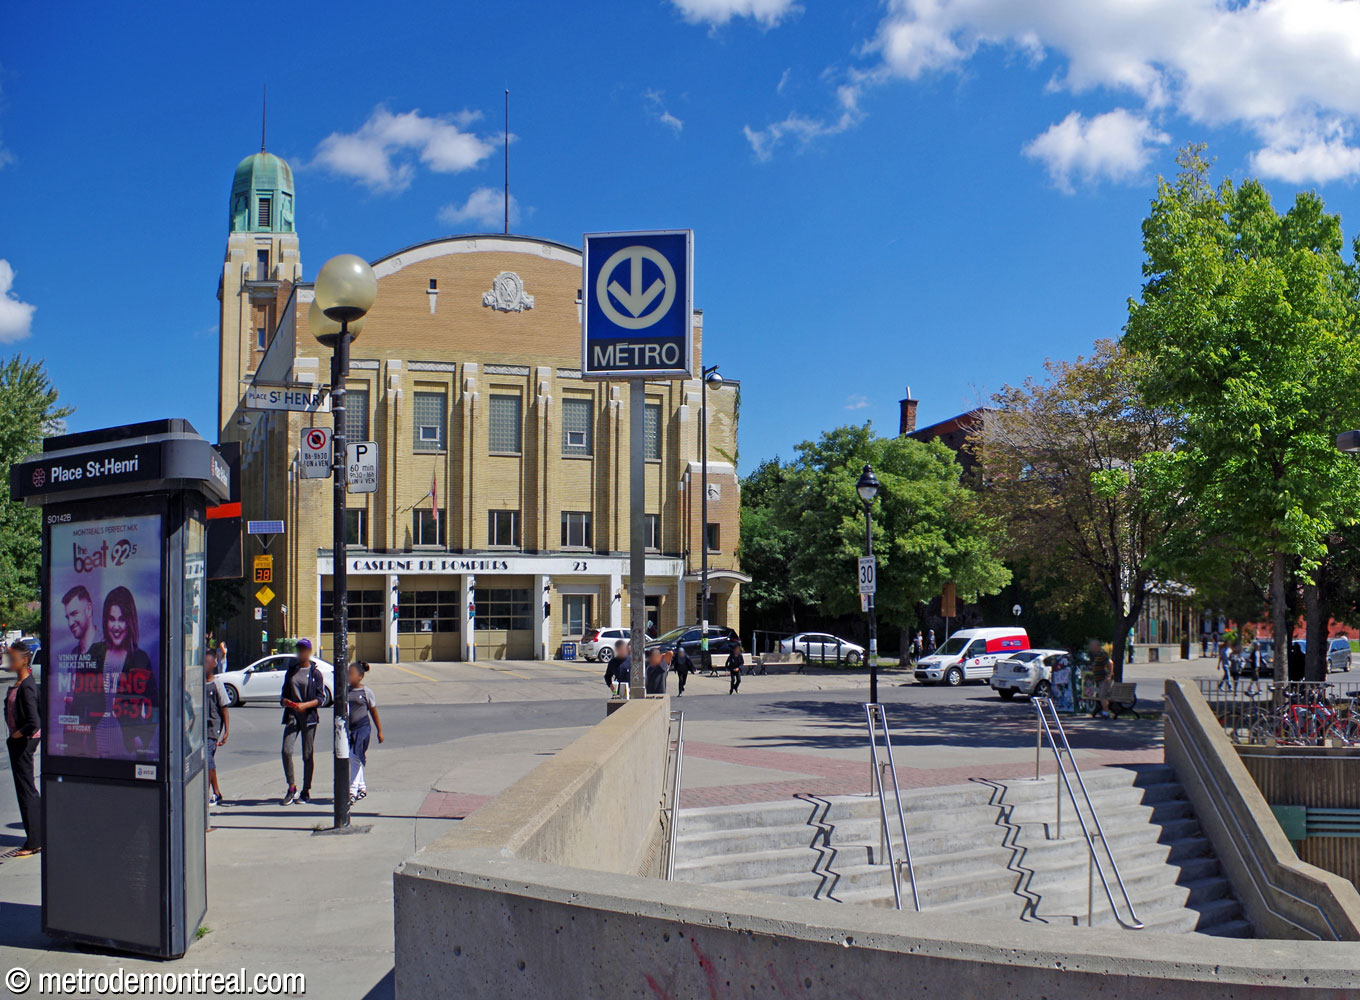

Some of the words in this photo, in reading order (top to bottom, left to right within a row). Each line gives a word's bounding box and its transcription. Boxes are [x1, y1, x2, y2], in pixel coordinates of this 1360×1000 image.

[593, 342, 680, 367] MÉTRO
[248, 392, 267, 400] PLACE
[284, 392, 325, 407] HENRI
[355, 444, 368, 463] P
[51, 465, 83, 483] Place
[86, 455, 139, 478] St-Henri
[350, 464, 359, 473] 60
[104, 525, 126, 534] PERFECT
[127, 524, 138, 532] MIX
[73, 540, 109, 574] beat
[77, 544, 88, 555] the
[353, 560, 414, 571] CASERNE
[418, 560, 437, 571] DE
[441, 561, 509, 571] POMPIERS
[572, 561, 588, 571] 23
[860, 565, 873, 583] 30
[256, 569, 270, 581] 38
[58, 671, 147, 694] MORNING
[112, 697, 153, 719] 5:30
